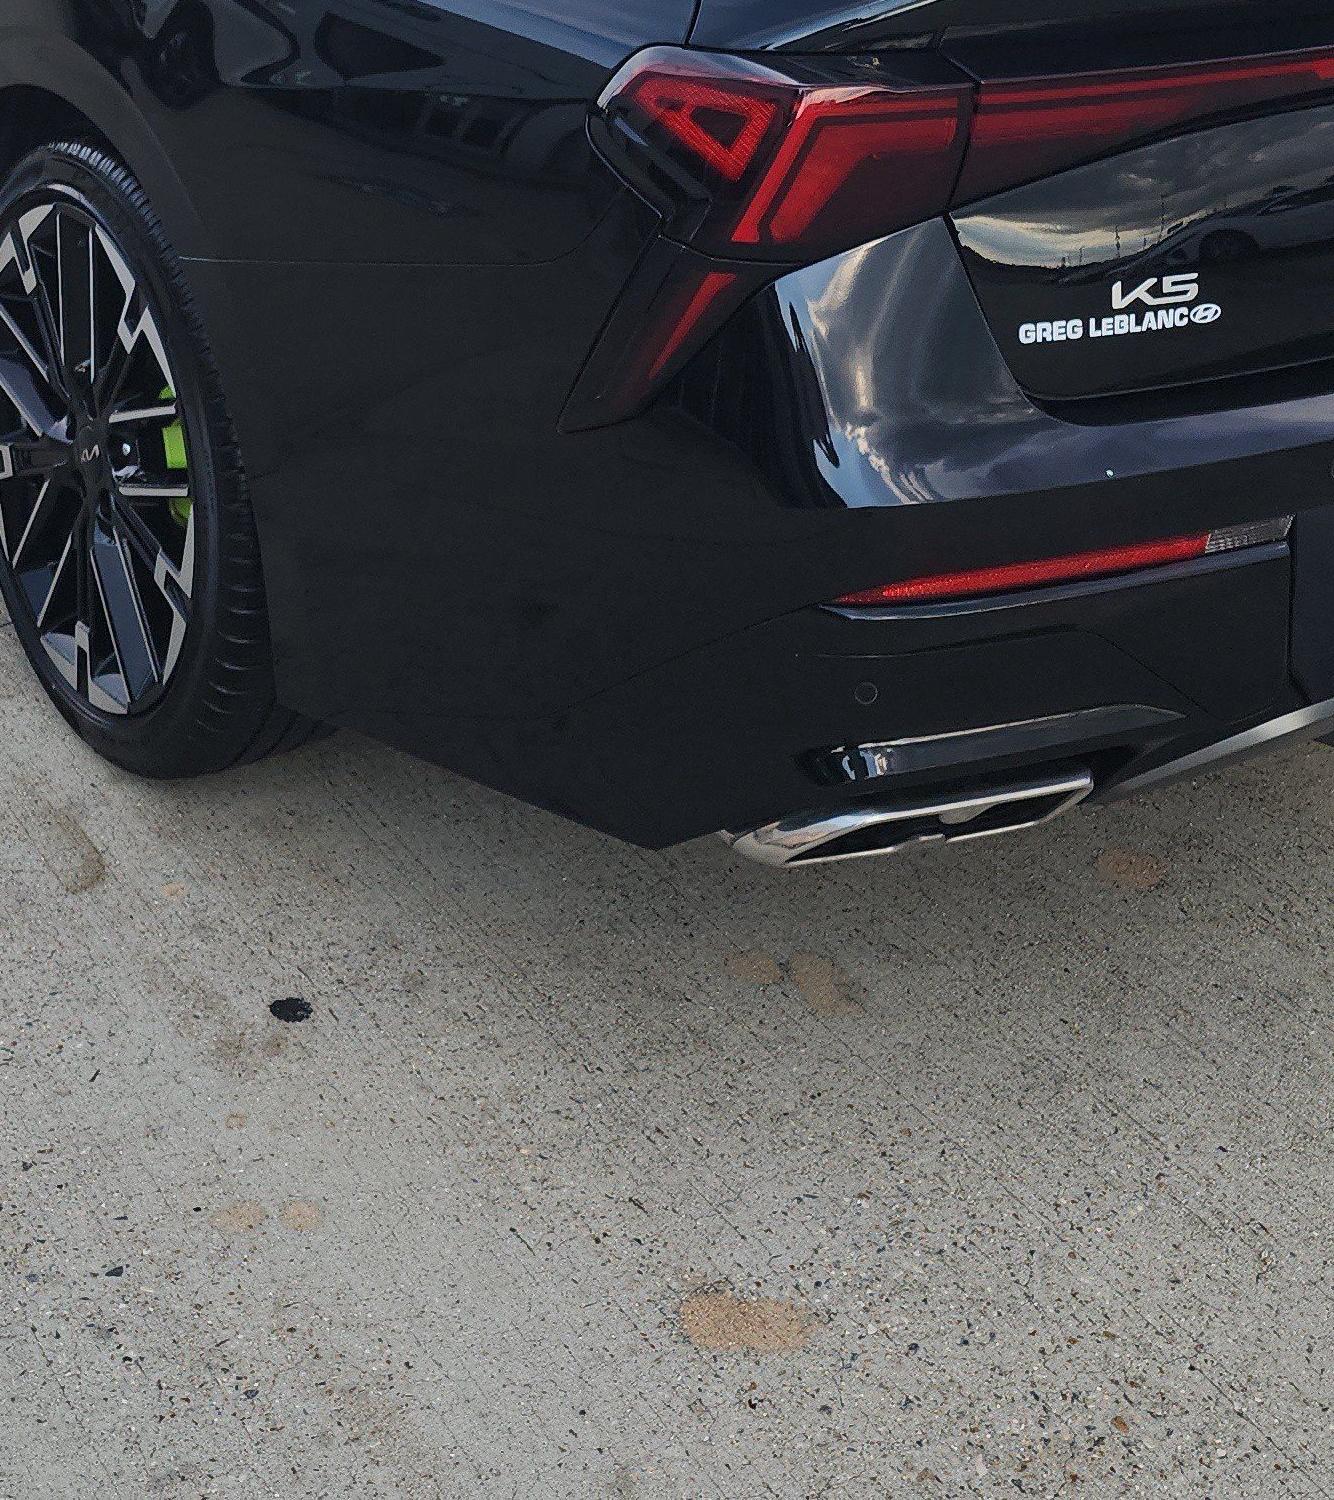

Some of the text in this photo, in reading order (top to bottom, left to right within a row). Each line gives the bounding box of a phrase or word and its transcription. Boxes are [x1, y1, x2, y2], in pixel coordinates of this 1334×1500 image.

[1112, 272, 1199, 310] K5
[1018, 306, 1190, 345] GREG LEBLANC
